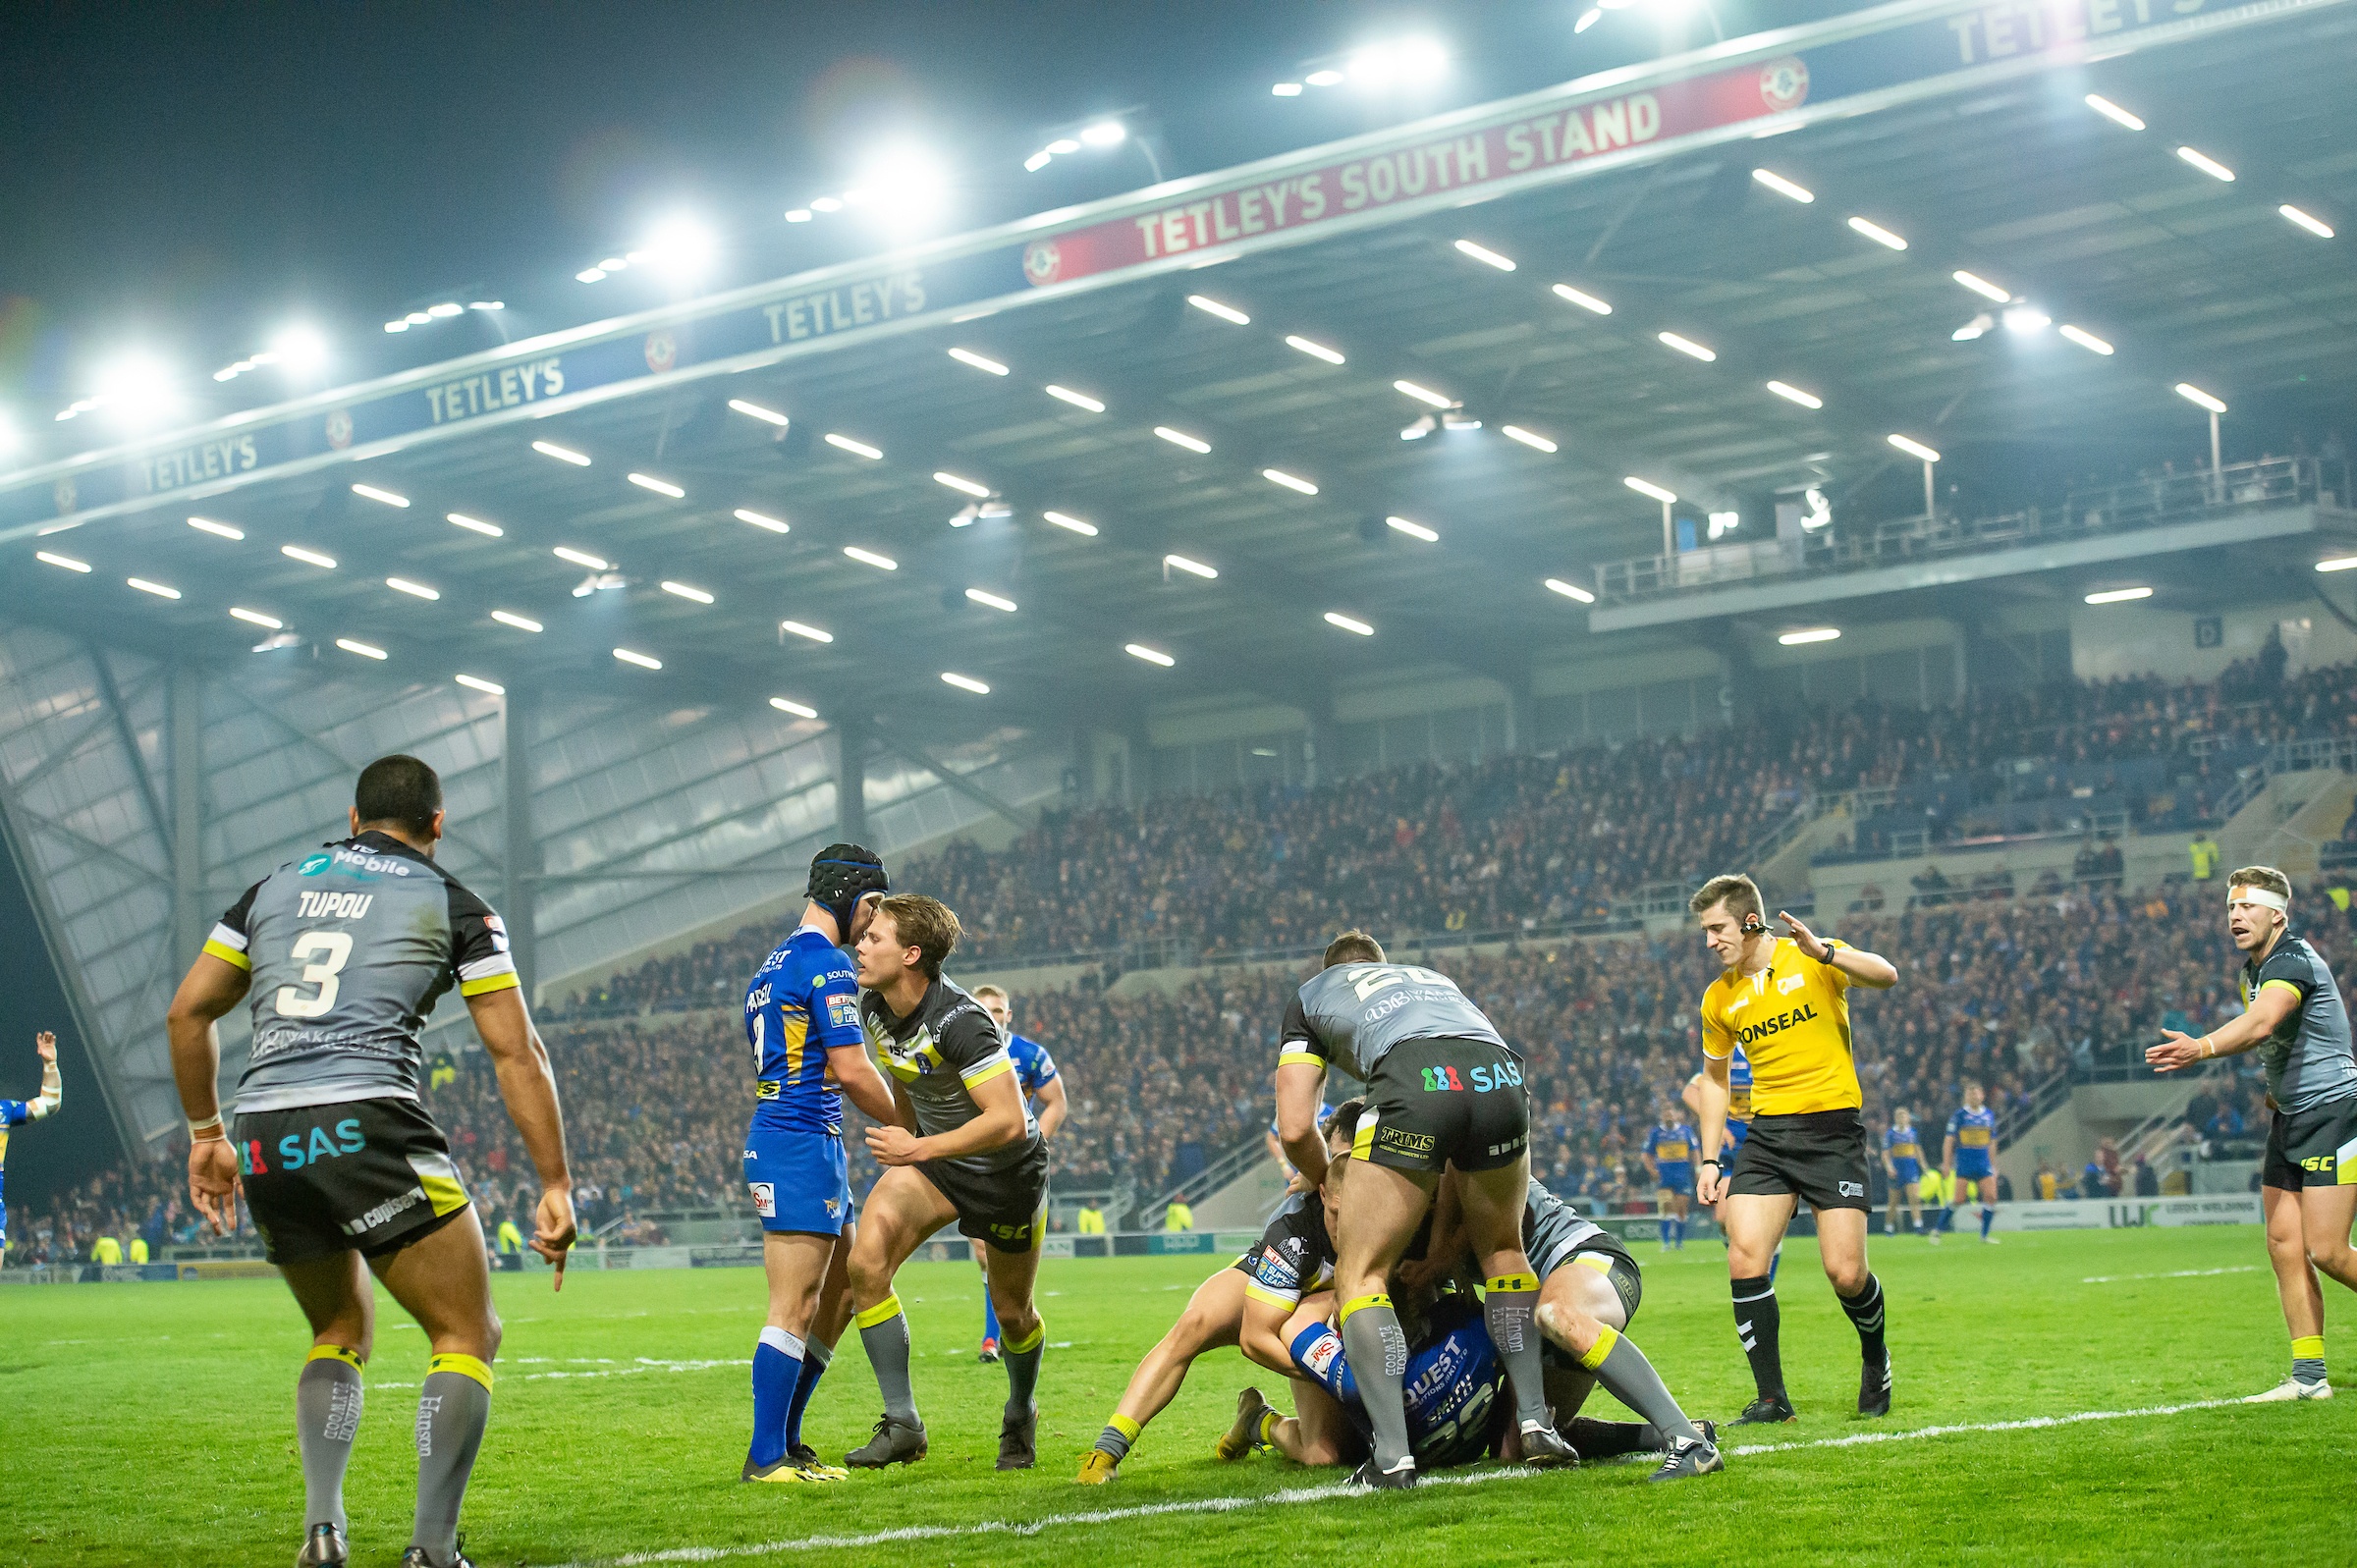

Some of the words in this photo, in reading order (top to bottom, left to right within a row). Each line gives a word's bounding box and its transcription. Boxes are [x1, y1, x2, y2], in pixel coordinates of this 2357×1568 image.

[1135, 175, 1327, 258] TETLEY'S
[1340, 134, 1489, 211] SOUTH
[1505, 94, 1661, 172] STAND
[763, 271, 927, 343] TETLEY'S
[426, 358, 565, 424] TETLEY'S
[141, 434, 257, 491] TETLEY'S
[333, 850, 411, 877] Mobile
[297, 891, 374, 919] TUPOU
[275, 932, 354, 1018] 3
[1734, 1003, 1818, 1045] RONSEAL
[1469, 1061, 1523, 1093] SAS
[279, 1118, 366, 1170] SAS
[1381, 1126, 1435, 1151] TRIMS
[2300, 1156, 2335, 1172] ISC
[989, 1223, 1030, 1240] ISC
[1263, 1245, 1299, 1278] BETFRED
[1379, 1325, 1396, 1376] PLYWOOD
[1493, 1307, 1508, 1354] PLYWOOD
[1506, 1307, 1531, 1353] Hanson
[1403, 1335, 1461, 1407] QUEST
[415, 1395, 443, 1457] Hanson
